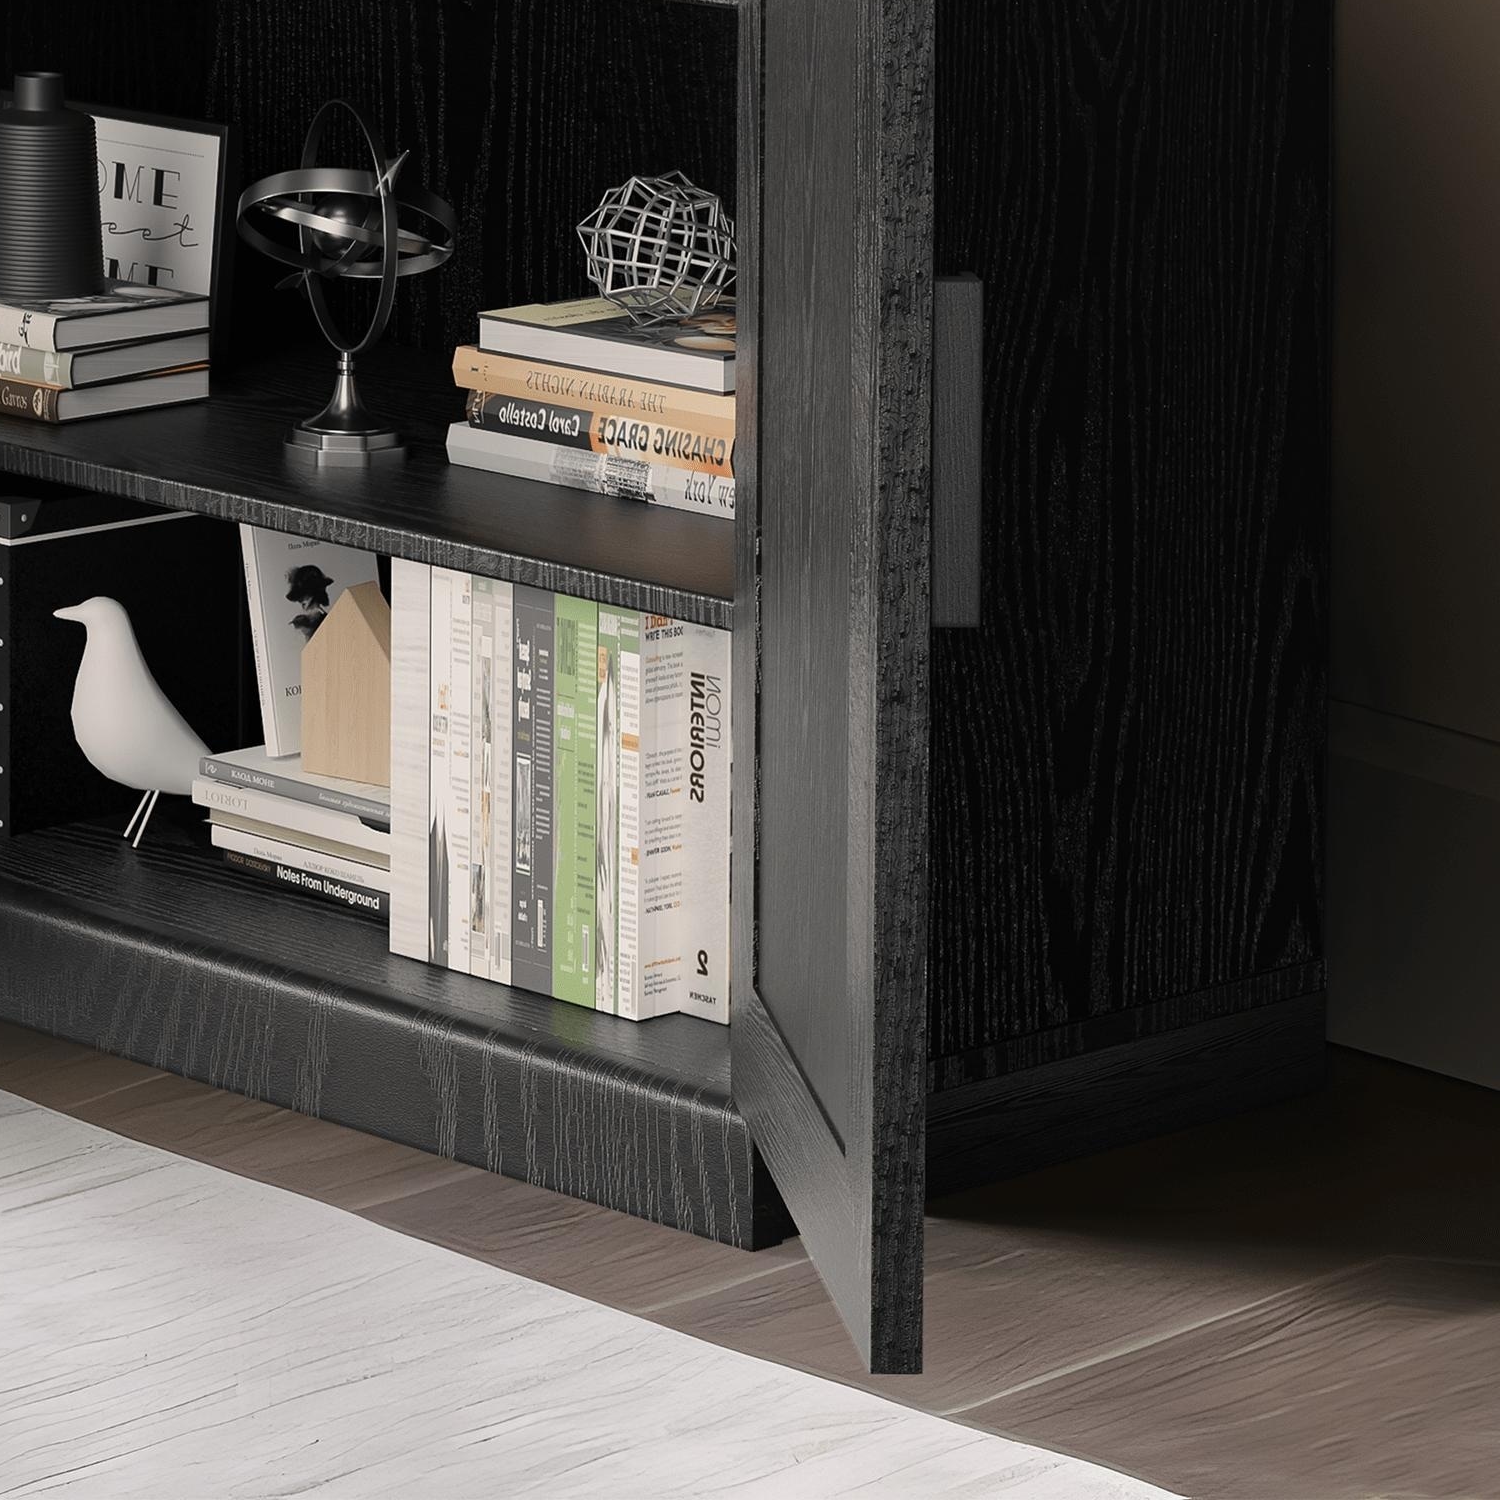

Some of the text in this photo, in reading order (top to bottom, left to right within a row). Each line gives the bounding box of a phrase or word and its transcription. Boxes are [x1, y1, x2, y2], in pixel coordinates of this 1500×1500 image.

[100, 214, 198, 247] eet
[252, 775, 275, 789] МОНЕ
[276, 865, 380, 909] Notes From Underground
